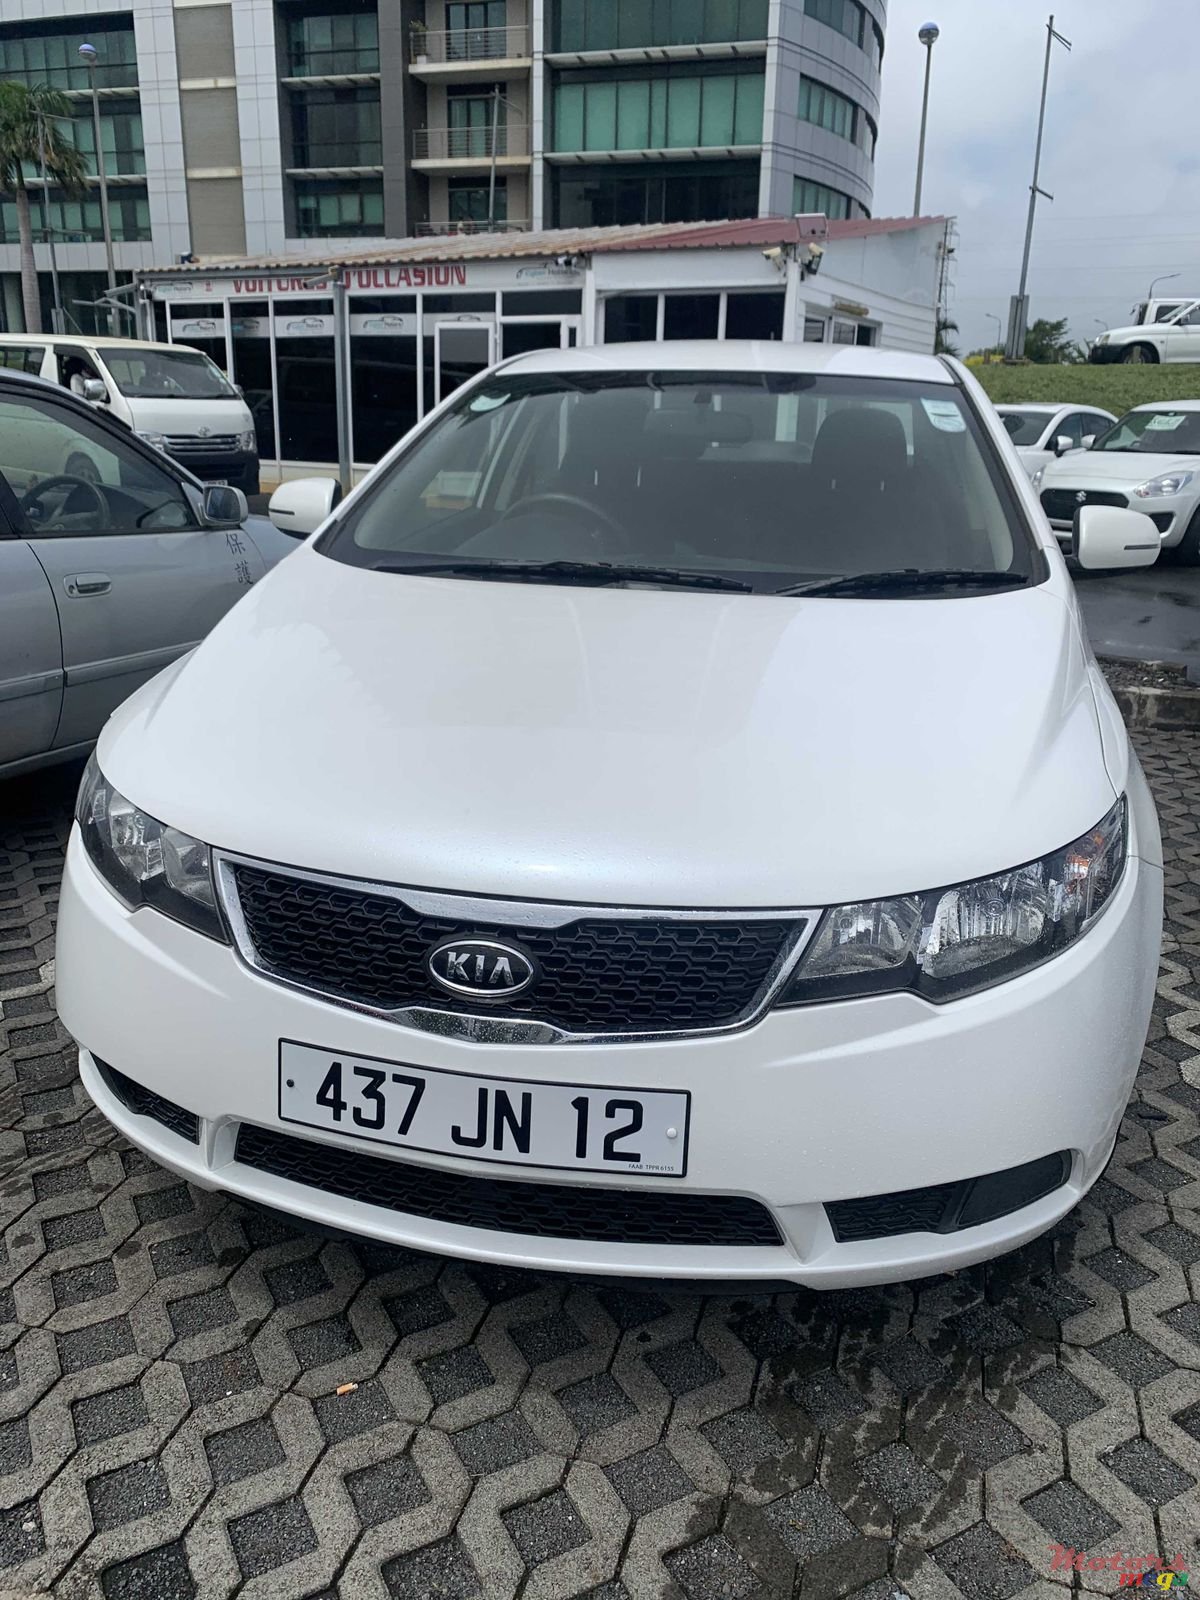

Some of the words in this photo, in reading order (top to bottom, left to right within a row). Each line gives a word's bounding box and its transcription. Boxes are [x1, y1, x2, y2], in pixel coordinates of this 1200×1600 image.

[233, 278, 327, 293] VOITUR
[446, 951, 515, 986] KIA
[315, 1061, 426, 1136] 437
[451, 1087, 532, 1154] JN
[570, 1096, 644, 1162] 12
